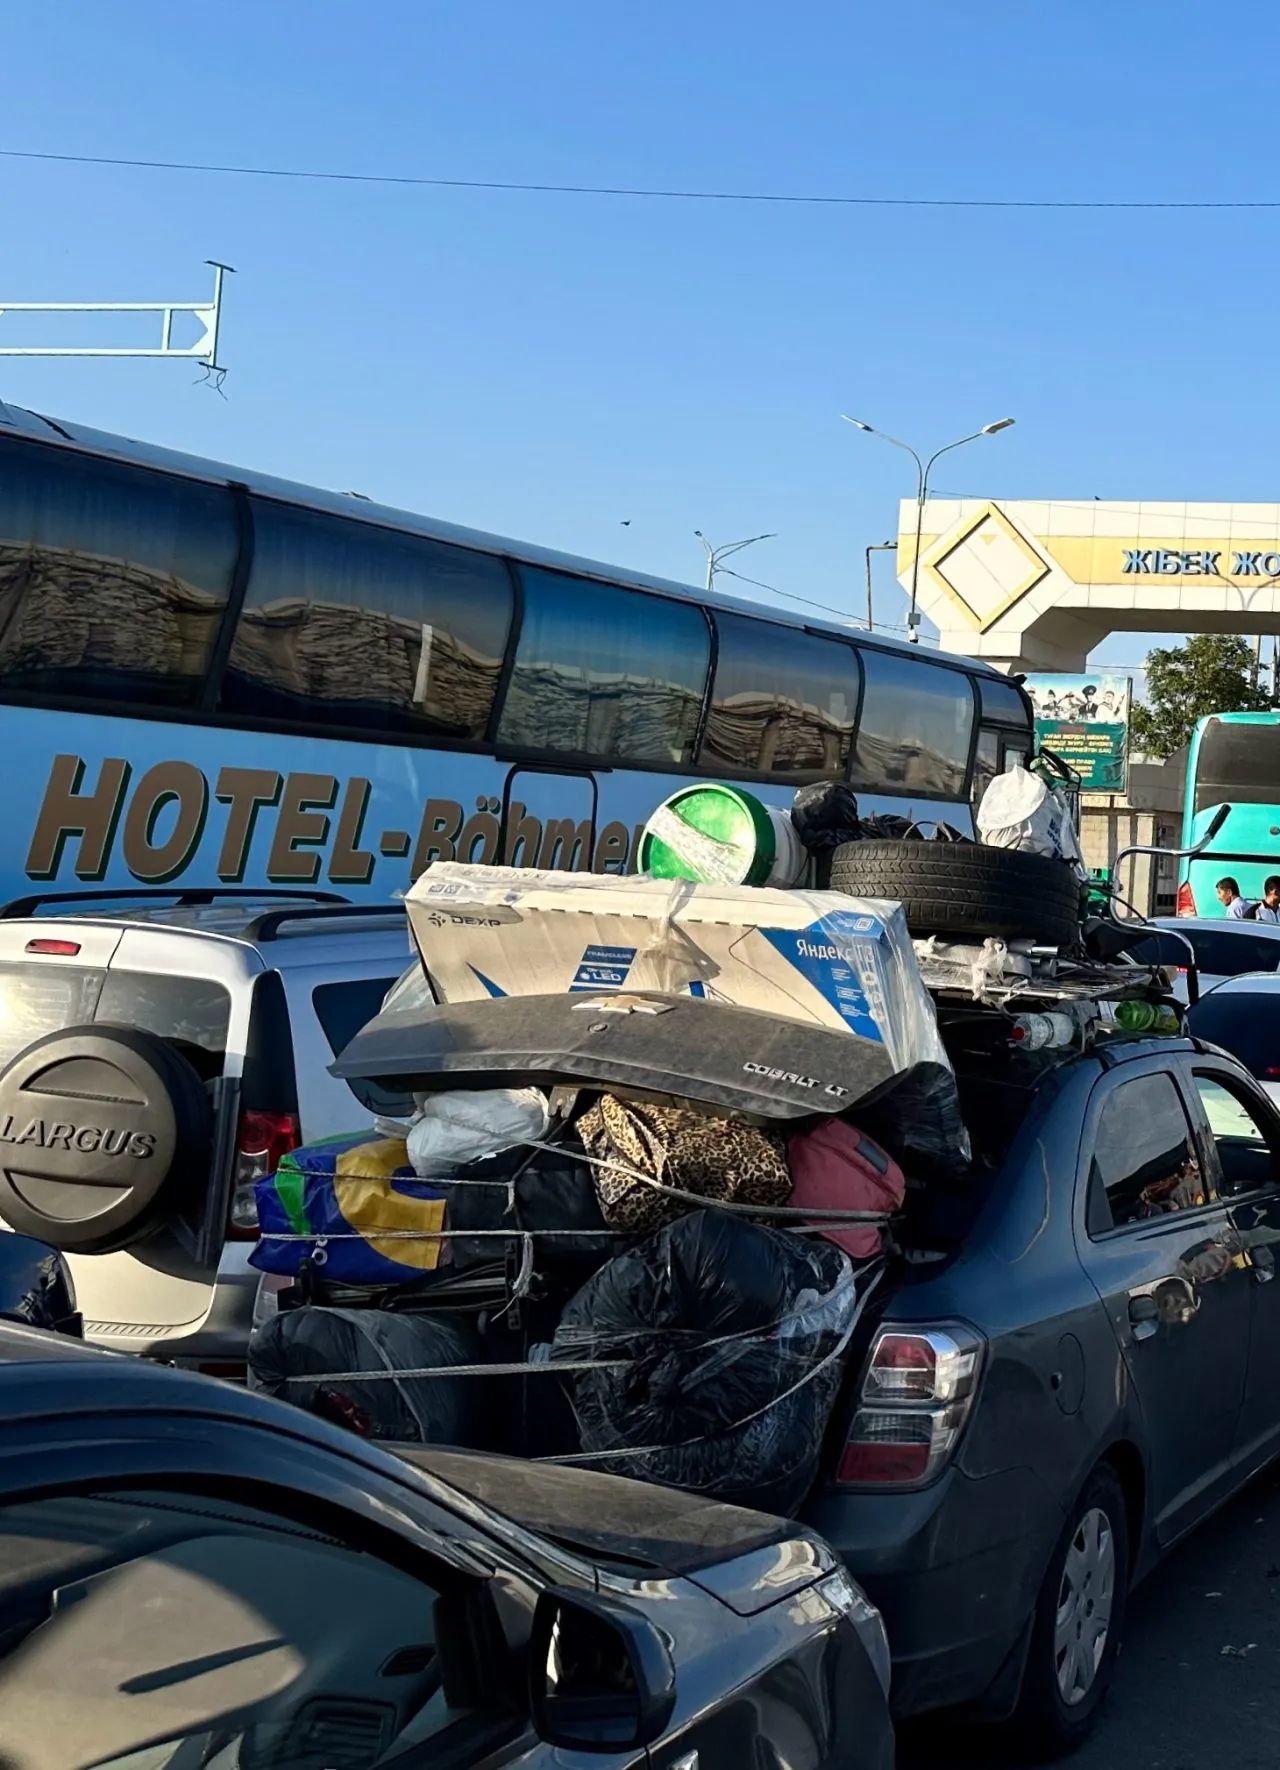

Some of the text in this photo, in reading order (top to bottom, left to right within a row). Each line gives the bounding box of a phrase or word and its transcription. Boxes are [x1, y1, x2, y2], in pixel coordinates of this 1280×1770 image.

[1122, 549, 1221, 575] ЖІБЕК
[451, 916, 501, 927] DEXP
[592, 972, 622, 982] LED
[743, 1061, 848, 1096] COBALT LT
[0, 1112, 157, 1159] LARGUS
